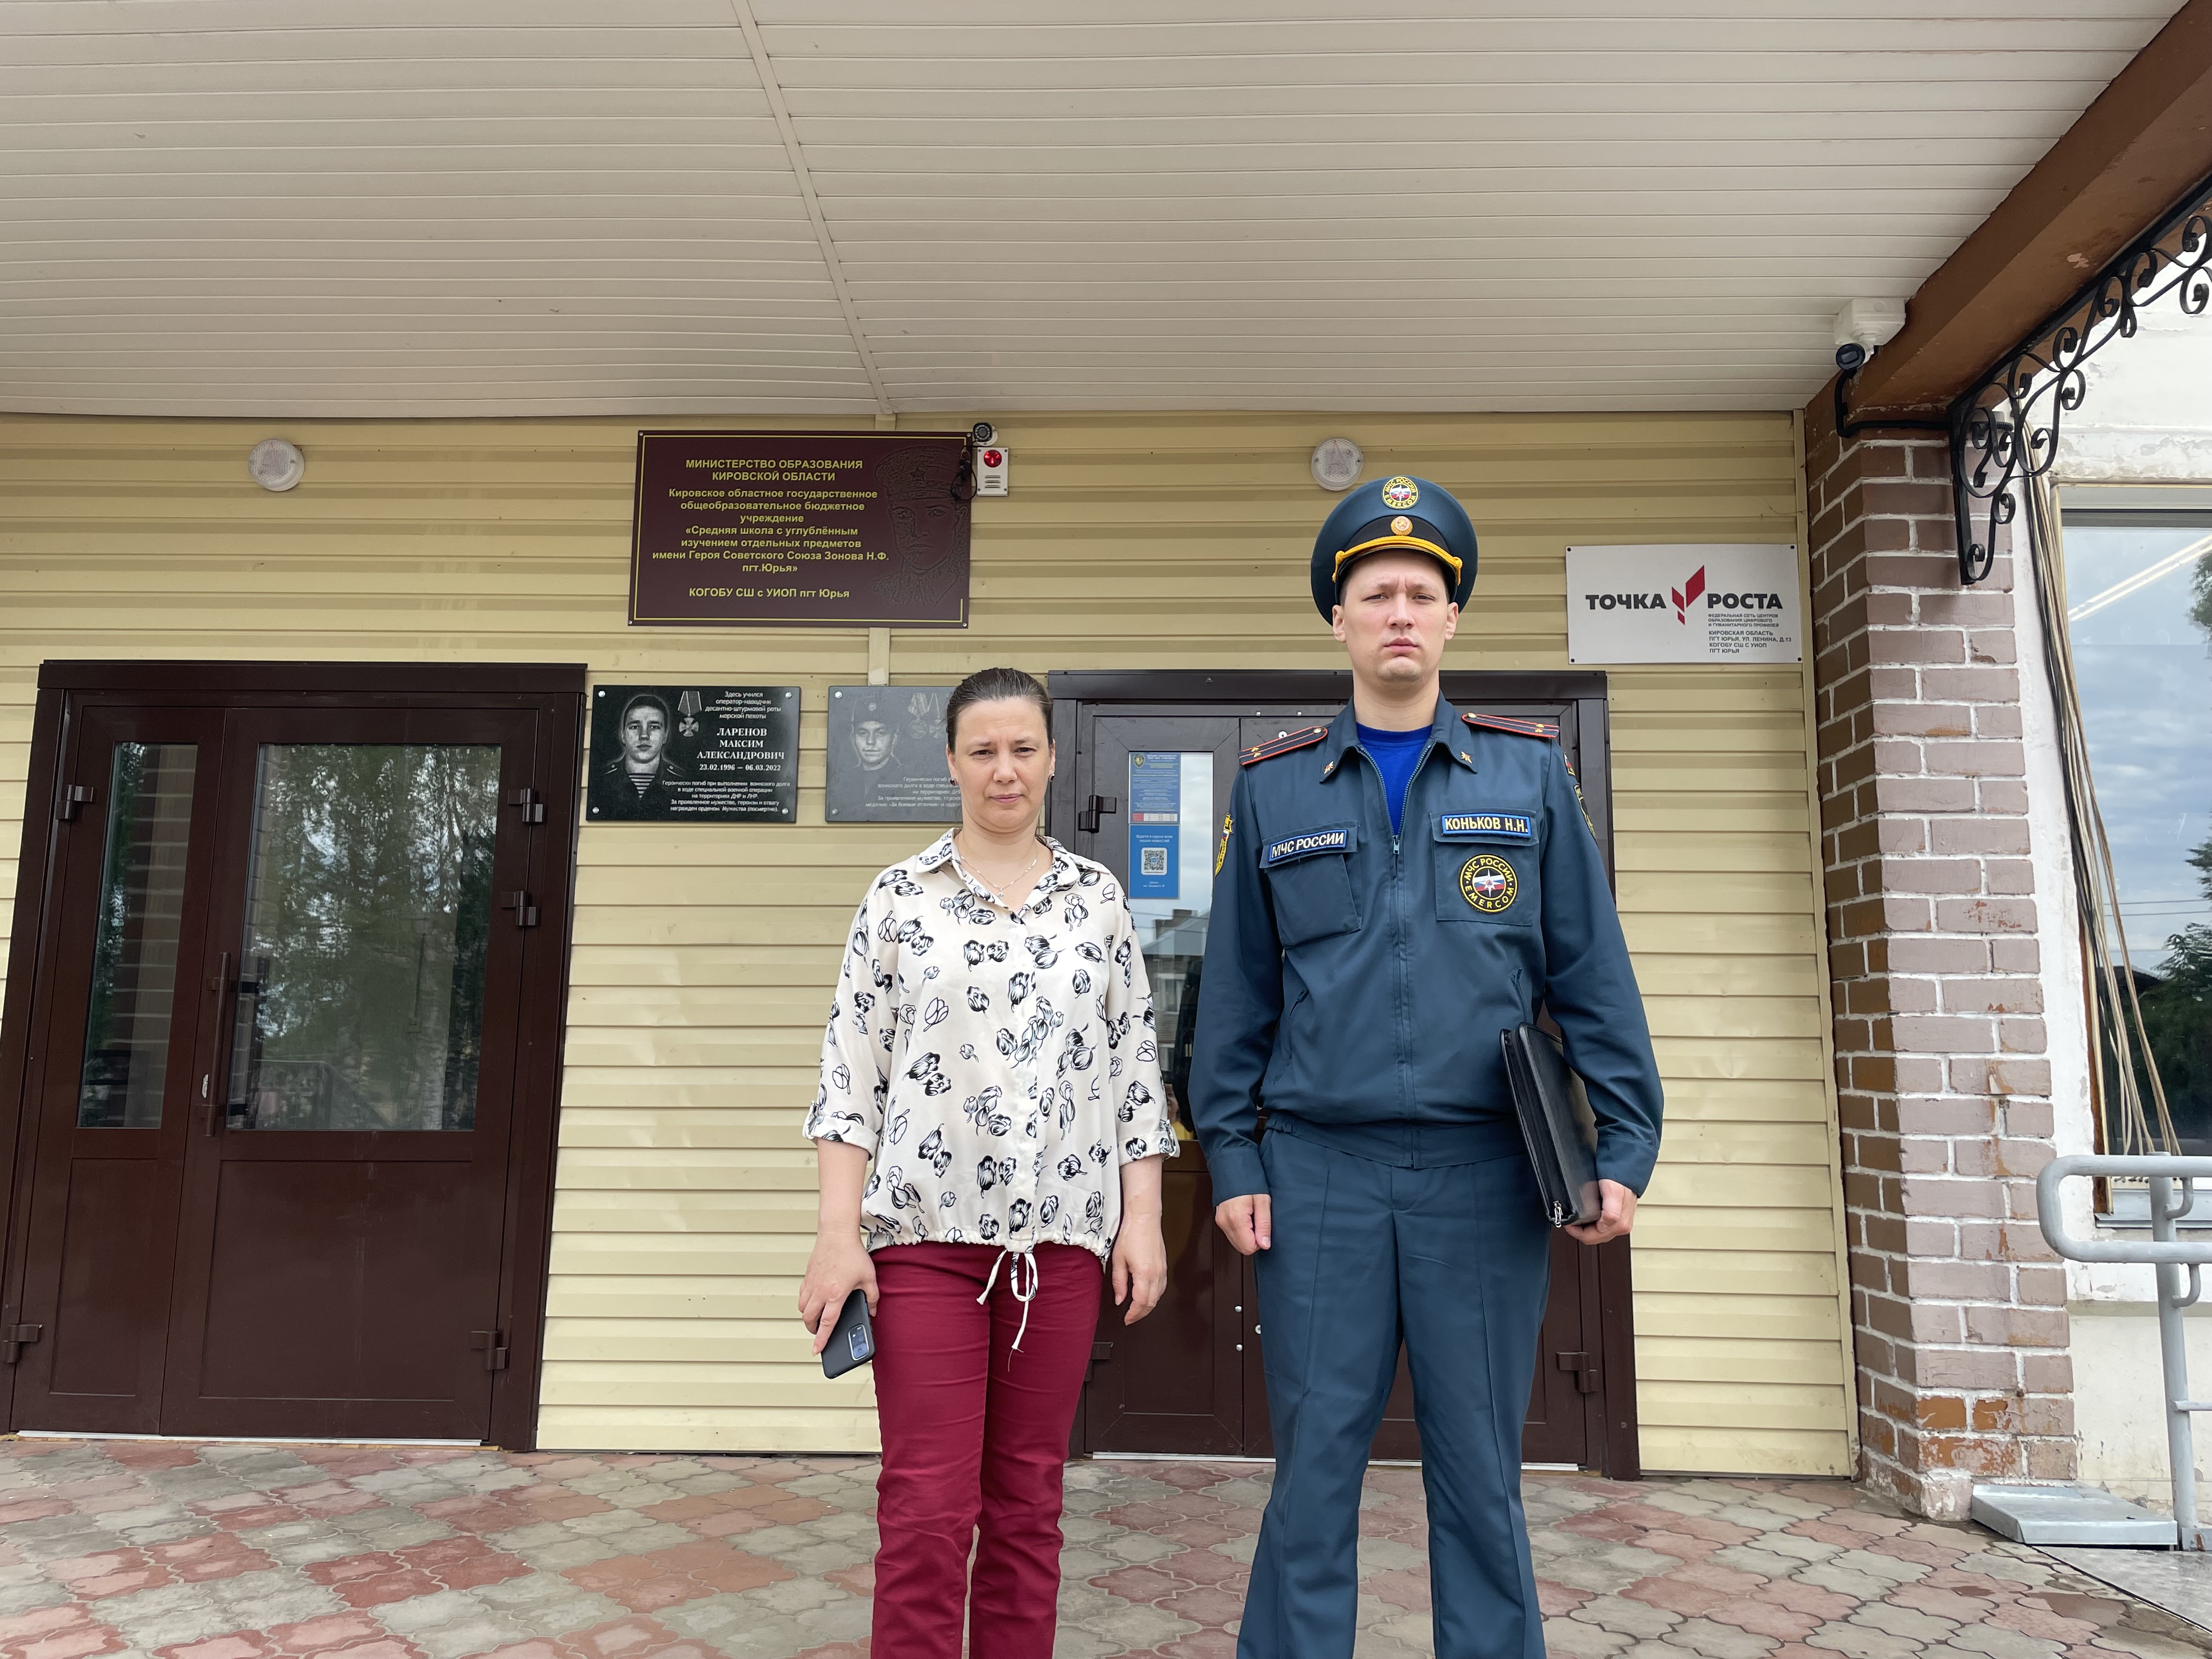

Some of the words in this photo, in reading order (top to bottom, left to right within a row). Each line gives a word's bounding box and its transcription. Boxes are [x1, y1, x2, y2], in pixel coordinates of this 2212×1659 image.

[686, 459, 776, 469] МИНИСТЕРСТВО
[778, 459, 863, 469] ОБРАЗОВАНИЯ
[712, 470, 780, 481] КИРОВСКОЙ
[782, 472, 836, 481] ОБЛАСТИ
[669, 488, 725, 499] Кировское
[727, 488, 784, 498] областное
[786, 490, 878, 500] государственное
[680, 500, 802, 511] общеобразовательное
[804, 501, 865, 511] бюджетное
[740, 515, 804, 524] учреждение
[686, 525, 737, 537] «Средняя
[785, 526, 858, 537] углублённым
[681, 539, 738, 549] изучением
[741, 540, 800, 548] отдельных
[803, 540, 862, 549] предметов
[689, 550, 720, 561] Героя
[723, 550, 784, 560] Советского
[787, 551, 822, 560] Союза
[824, 551, 864, 560] Зонова
[866, 551, 889, 561] Н.Ф.
[742, 563, 798, 574] пгт.Юрья»
[689, 588, 733, 597] КОГОБУ
[736, 588, 754, 597] СШ
[766, 588, 797, 597] УИОП
[819, 589, 850, 600] Юрья
[1585, 593, 1667, 610] ТОЧКА
[1707, 592, 1784, 610] РОСТА
[716, 727, 768, 736] ЛАРЕНОВ
[719, 740, 764, 748] МАКСИМ
[697, 751, 785, 760] АЛЕКСАНДРОВИЧ
[1444, 816, 1501, 830] КОНЬКОВ
[1504, 817, 1528, 832] Н.Н.
[1271, 842, 1294, 859] МЧС
[1296, 833, 1345, 850] РОССИИ
[1464, 861, 1480, 881] МЧС
[1480, 857, 1514, 882] РОССИИ
[1465, 885, 1514, 909] EMERCOM
